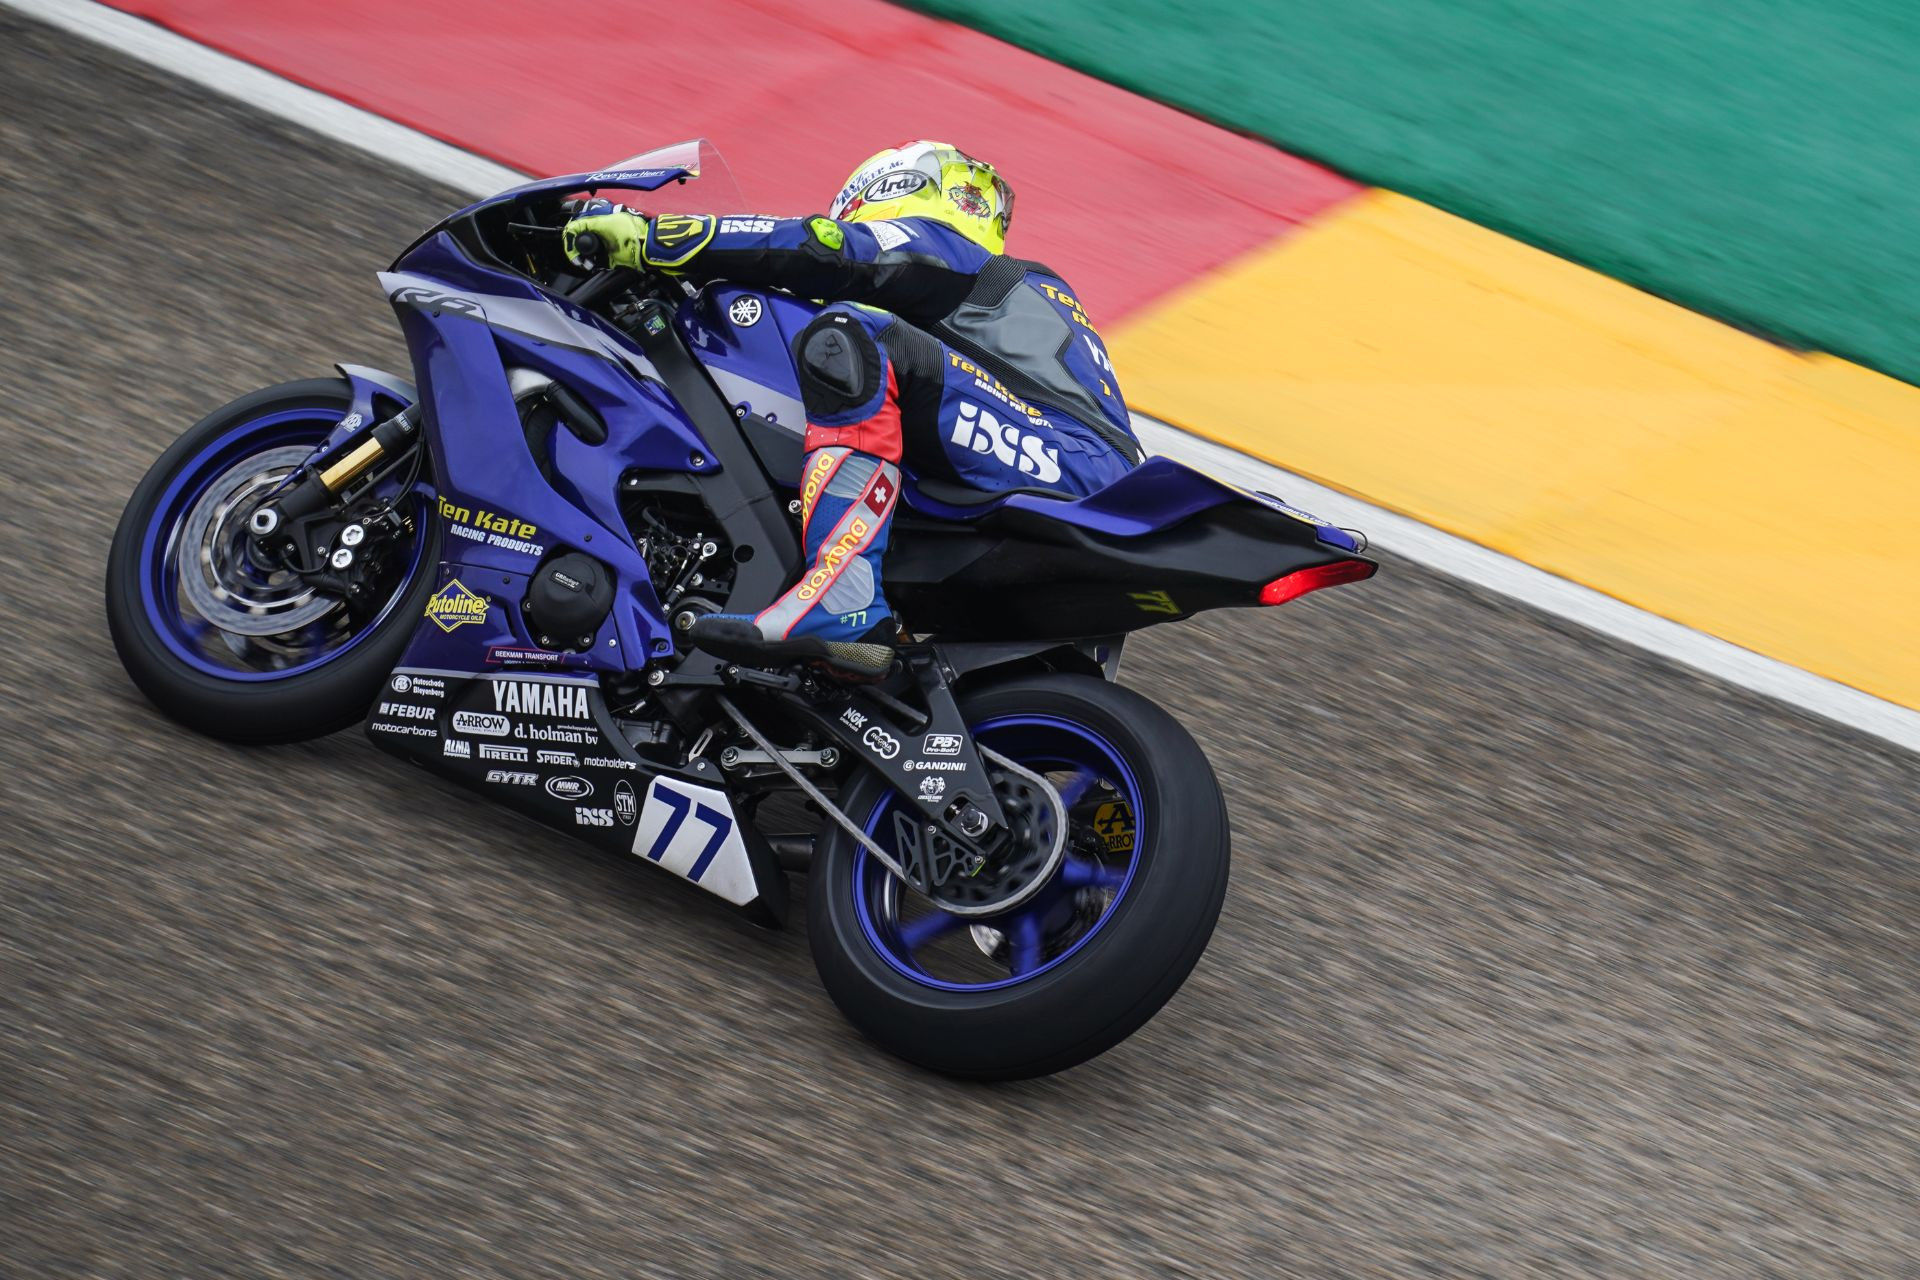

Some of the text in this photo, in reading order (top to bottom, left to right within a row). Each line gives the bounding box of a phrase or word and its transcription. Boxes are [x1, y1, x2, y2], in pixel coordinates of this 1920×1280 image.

[868, 176, 919, 199] Arai
[949, 352, 989, 382] Ten
[974, 378, 1008, 403] RACING
[439, 495, 537, 540] Ten Kate
[450, 523, 544, 556] RACING PRODUCTS
[797, 516, 870, 601] daytona
[427, 594, 484, 614] Putoline
[839, 610, 867, 627] #77
[524, 652, 559, 661] TRANSPORT
[492, 680, 589, 720] YAMAHA
[389, 703, 436, 720] FEBUR
[456, 713, 505, 730] ARROW
[843, 707, 868, 728] NGK
[372, 722, 438, 737] motocarbons
[530, 724, 583, 744] holman
[585, 732, 598, 745] bv
[479, 743, 528, 762] PIRELLI
[584, 756, 637, 770] motoholders
[486, 769, 539, 786] GYTR
[556, 781, 580, 791] MWR
[616, 793, 635, 813] STM
[647, 782, 733, 884] 77
